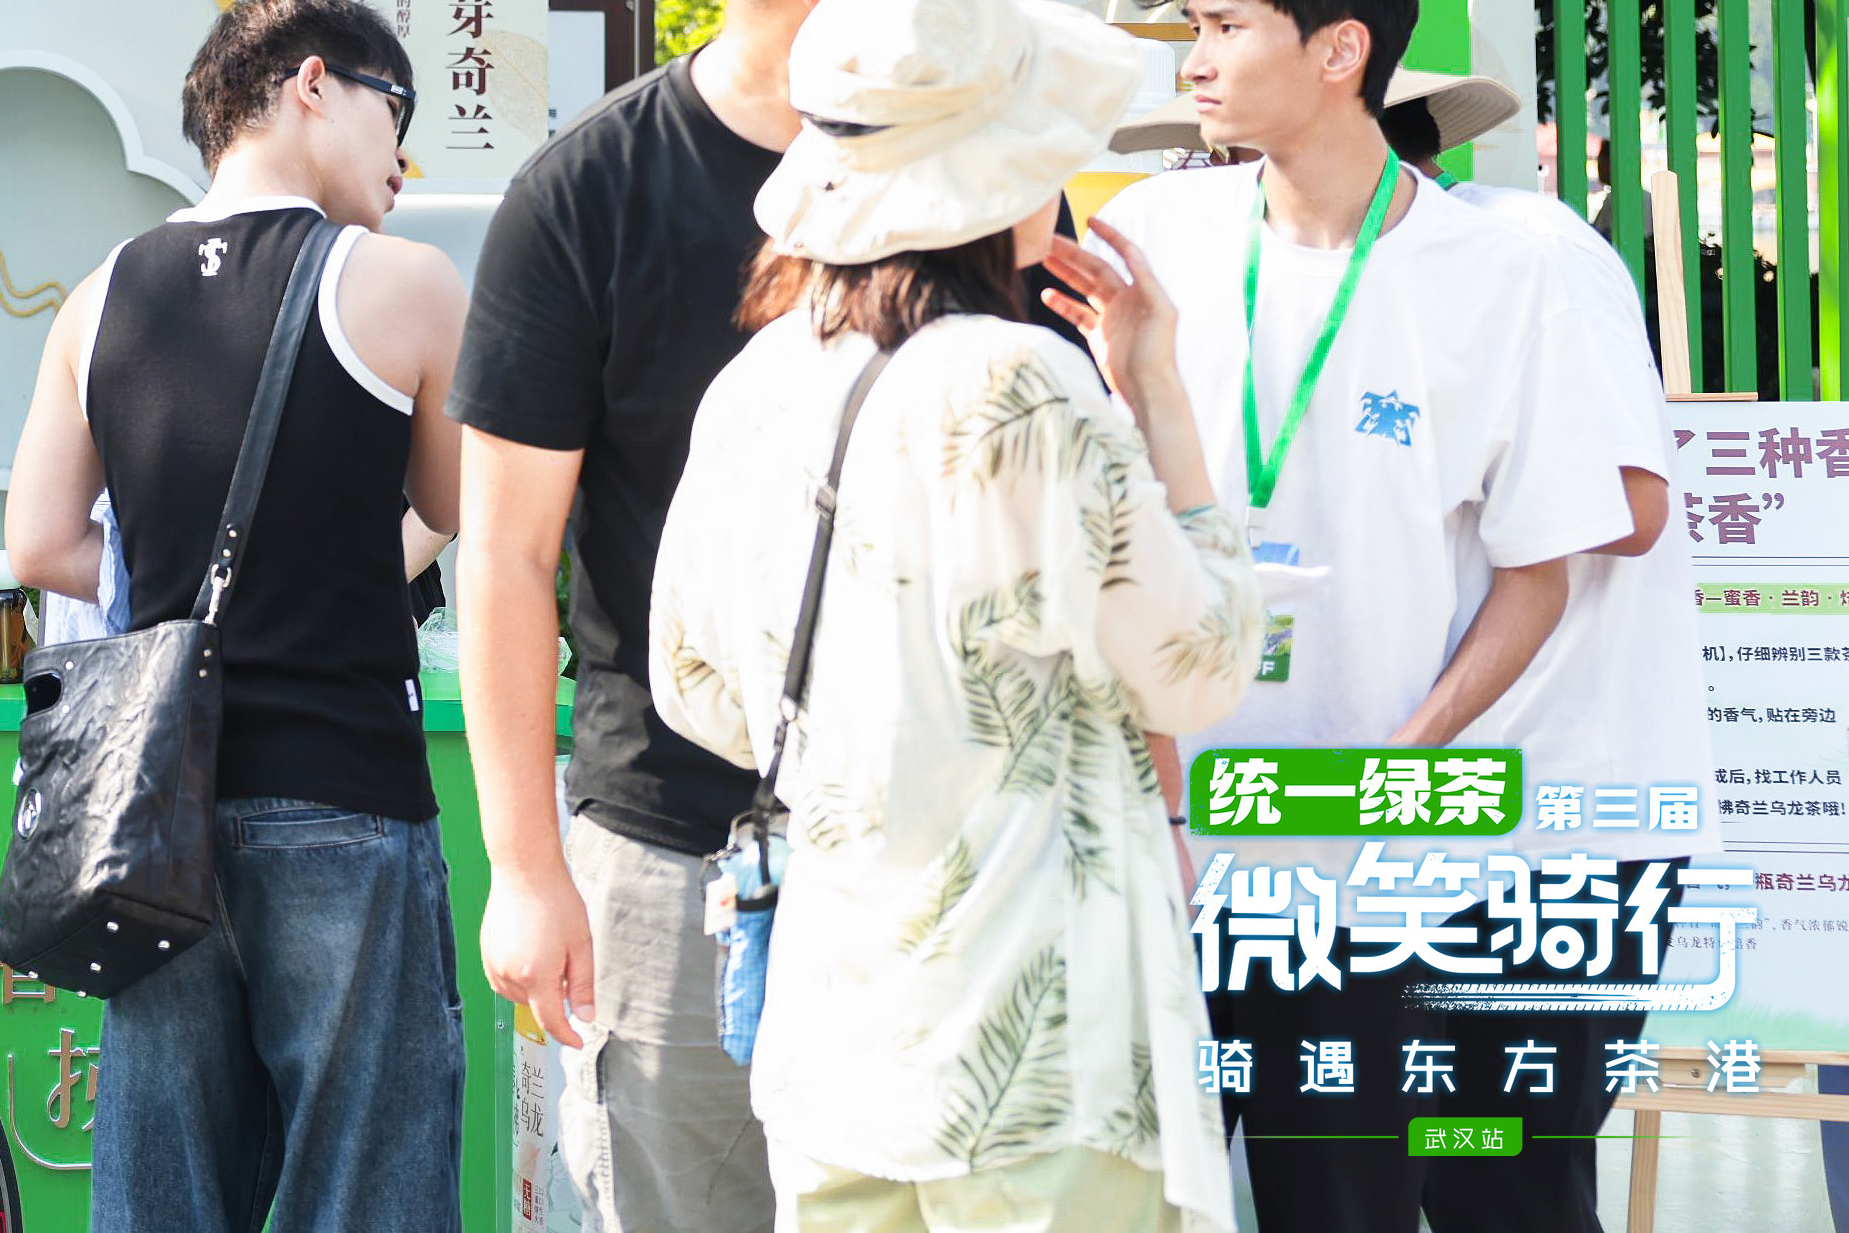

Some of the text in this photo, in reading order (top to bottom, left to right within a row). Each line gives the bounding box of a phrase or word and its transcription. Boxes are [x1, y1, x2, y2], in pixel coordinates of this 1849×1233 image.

[1707, 707, 1837, 723] 的香气，贴在旁边
